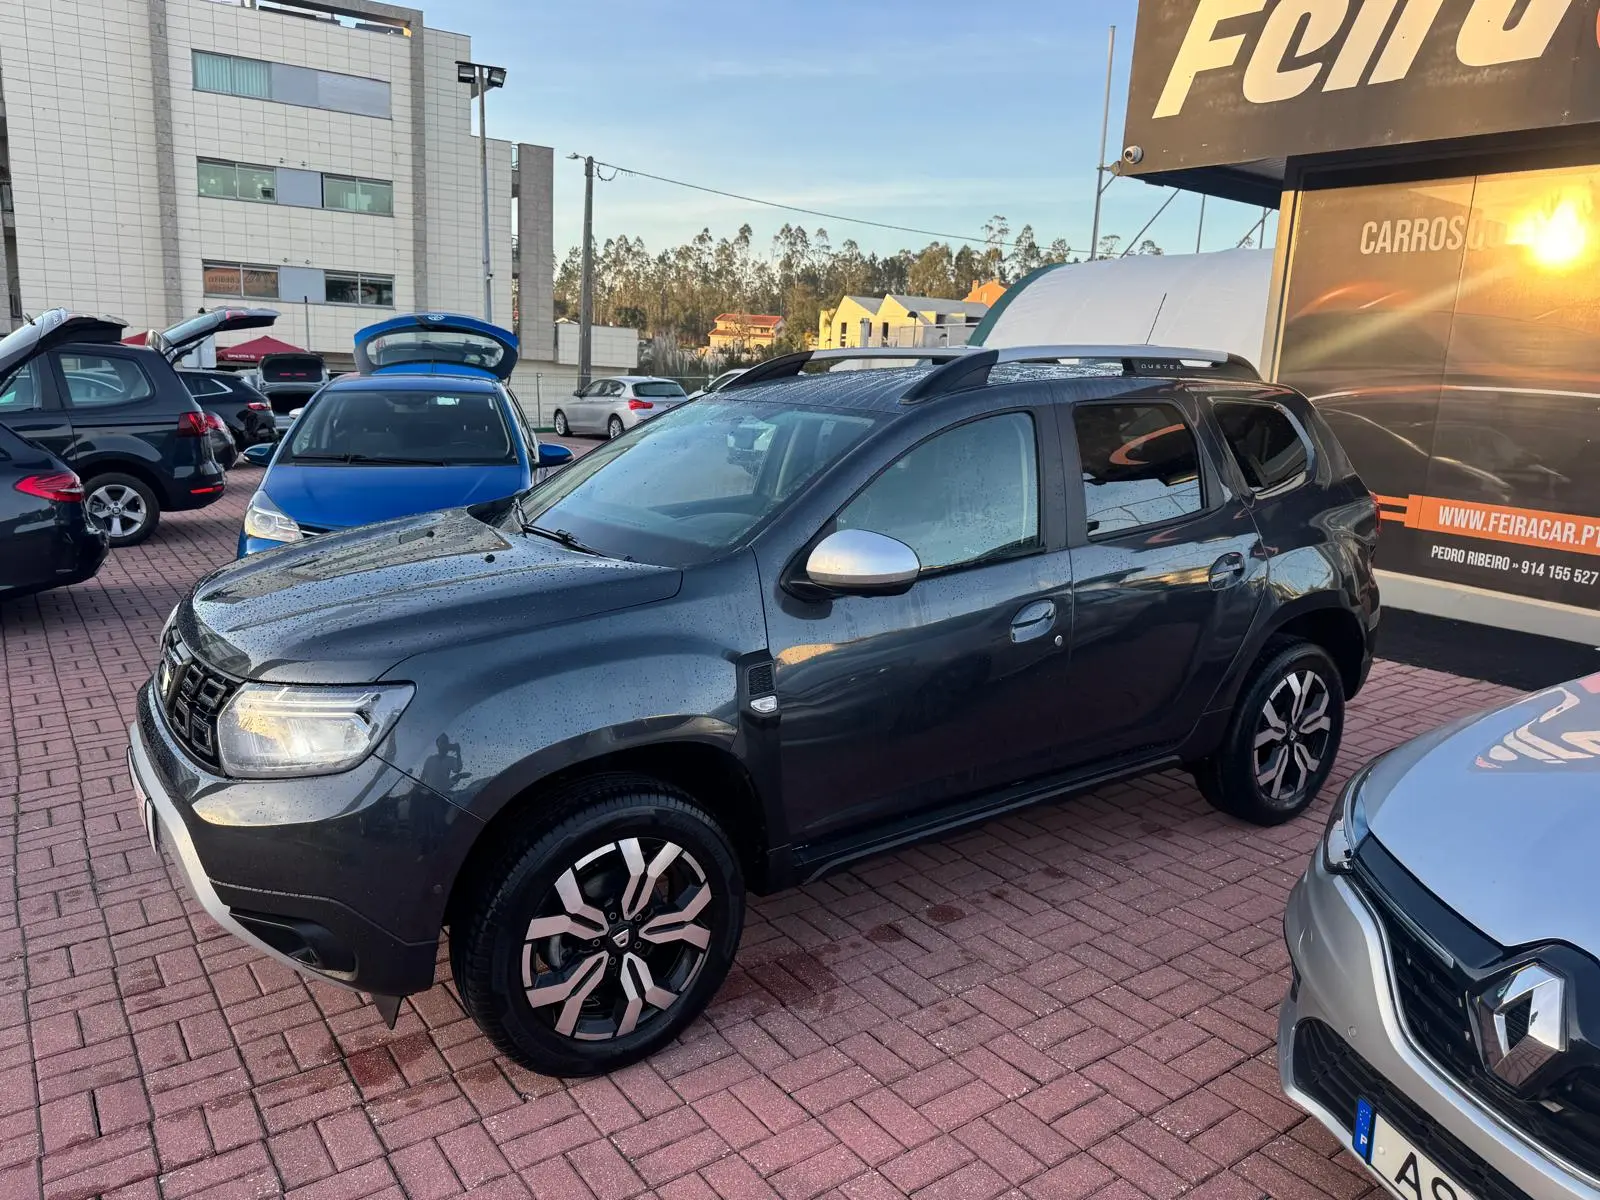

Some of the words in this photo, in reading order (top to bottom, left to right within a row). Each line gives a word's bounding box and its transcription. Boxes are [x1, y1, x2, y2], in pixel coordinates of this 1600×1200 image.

[1360, 215, 1465, 255] CARROS
[1431, 545, 1465, 564] PEDRO
[1466, 550, 1510, 571] RIBEIRO
[1521, 560, 1544, 577] 914
[1549, 565, 1572, 581] 155
[1573, 569, 1599, 585] 527
